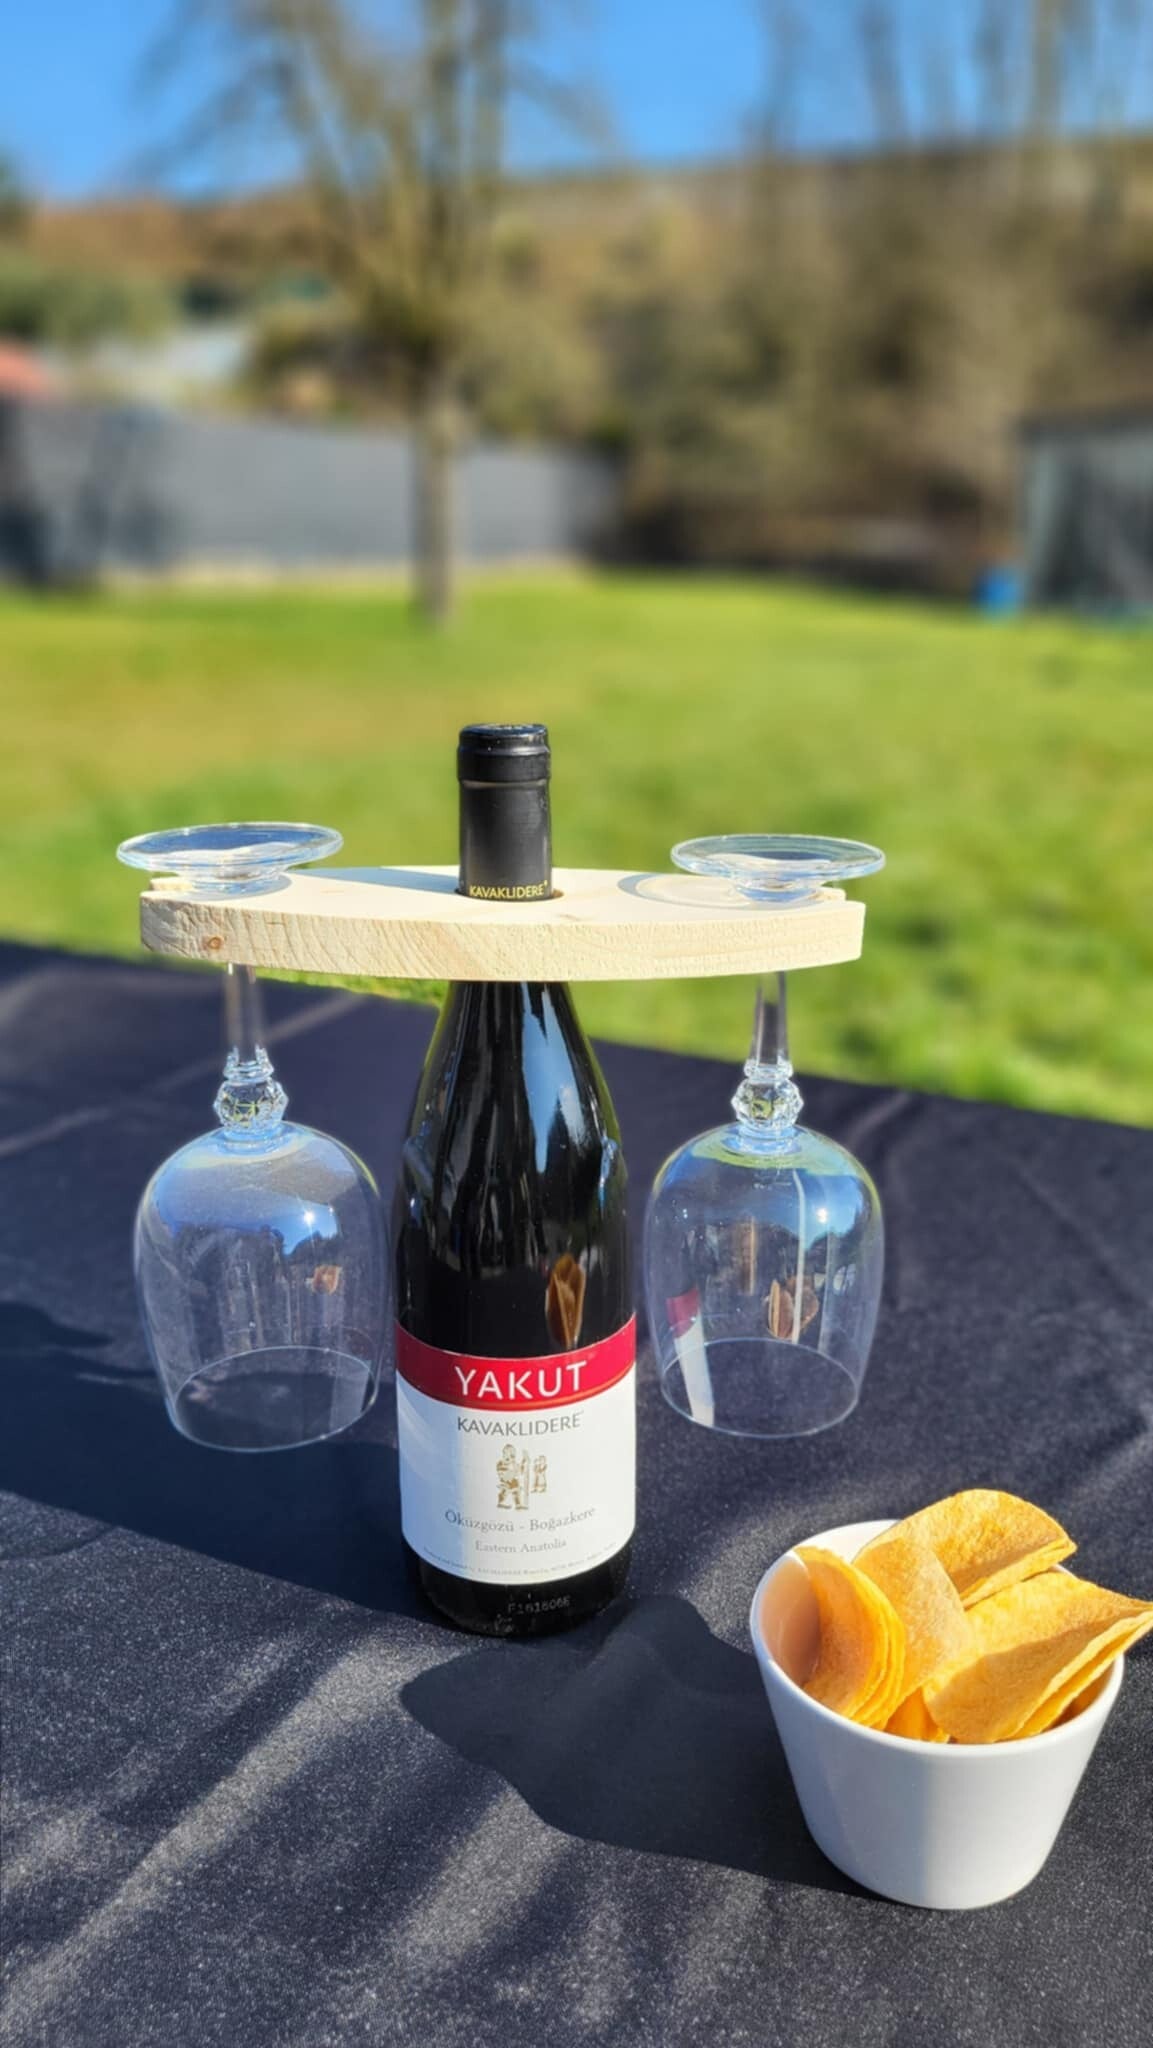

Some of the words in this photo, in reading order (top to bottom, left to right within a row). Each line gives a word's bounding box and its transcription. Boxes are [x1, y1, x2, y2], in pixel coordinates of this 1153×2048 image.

[469, 883, 546, 899] KAVAKLIDERE
[454, 1360, 587, 1400] YAKUT
[457, 1412, 582, 1437] KAVAKLIDERE
[475, 1540, 517, 1554] Eastern
[520, 1537, 567, 1554] Anatolia
